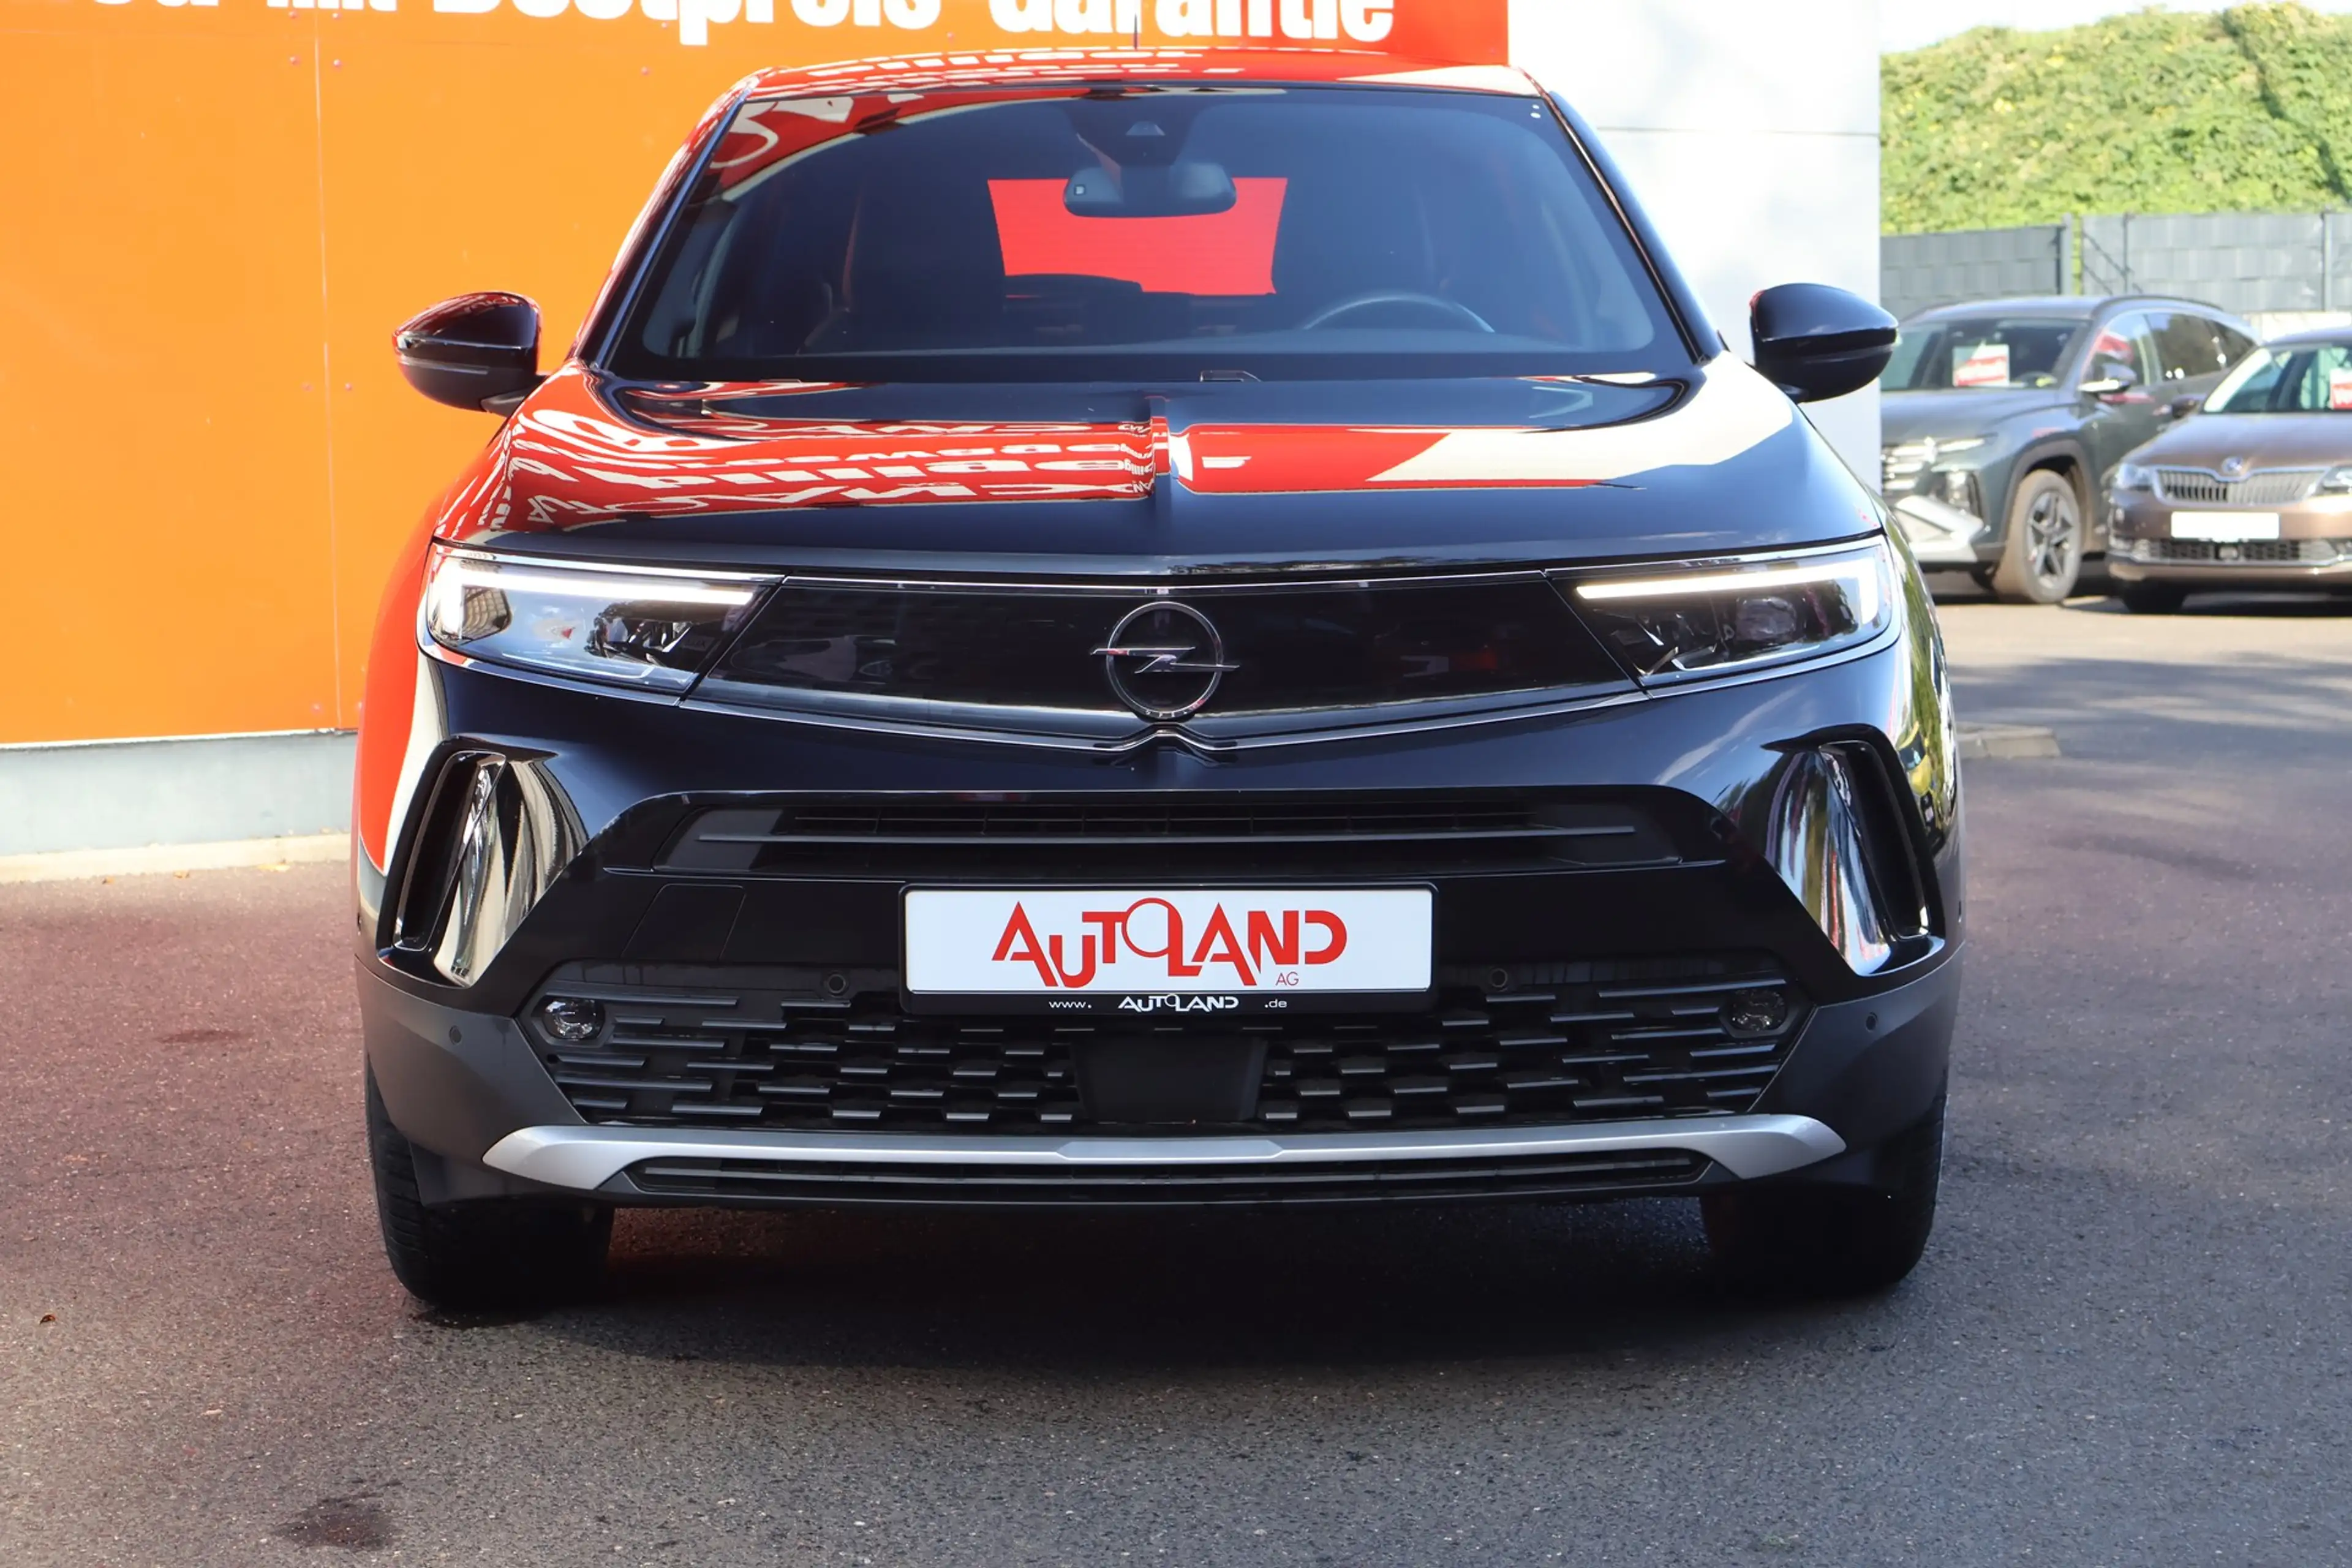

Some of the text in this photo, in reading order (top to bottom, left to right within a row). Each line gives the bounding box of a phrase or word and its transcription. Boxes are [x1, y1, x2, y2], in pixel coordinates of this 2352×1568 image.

[992, 897, 1347, 987] AUTOLAND
[1275, 971, 1299, 986] AG
[1118, 993, 1239, 1012] AUTOLAND
[1264, 998, 1287, 1008] .de
